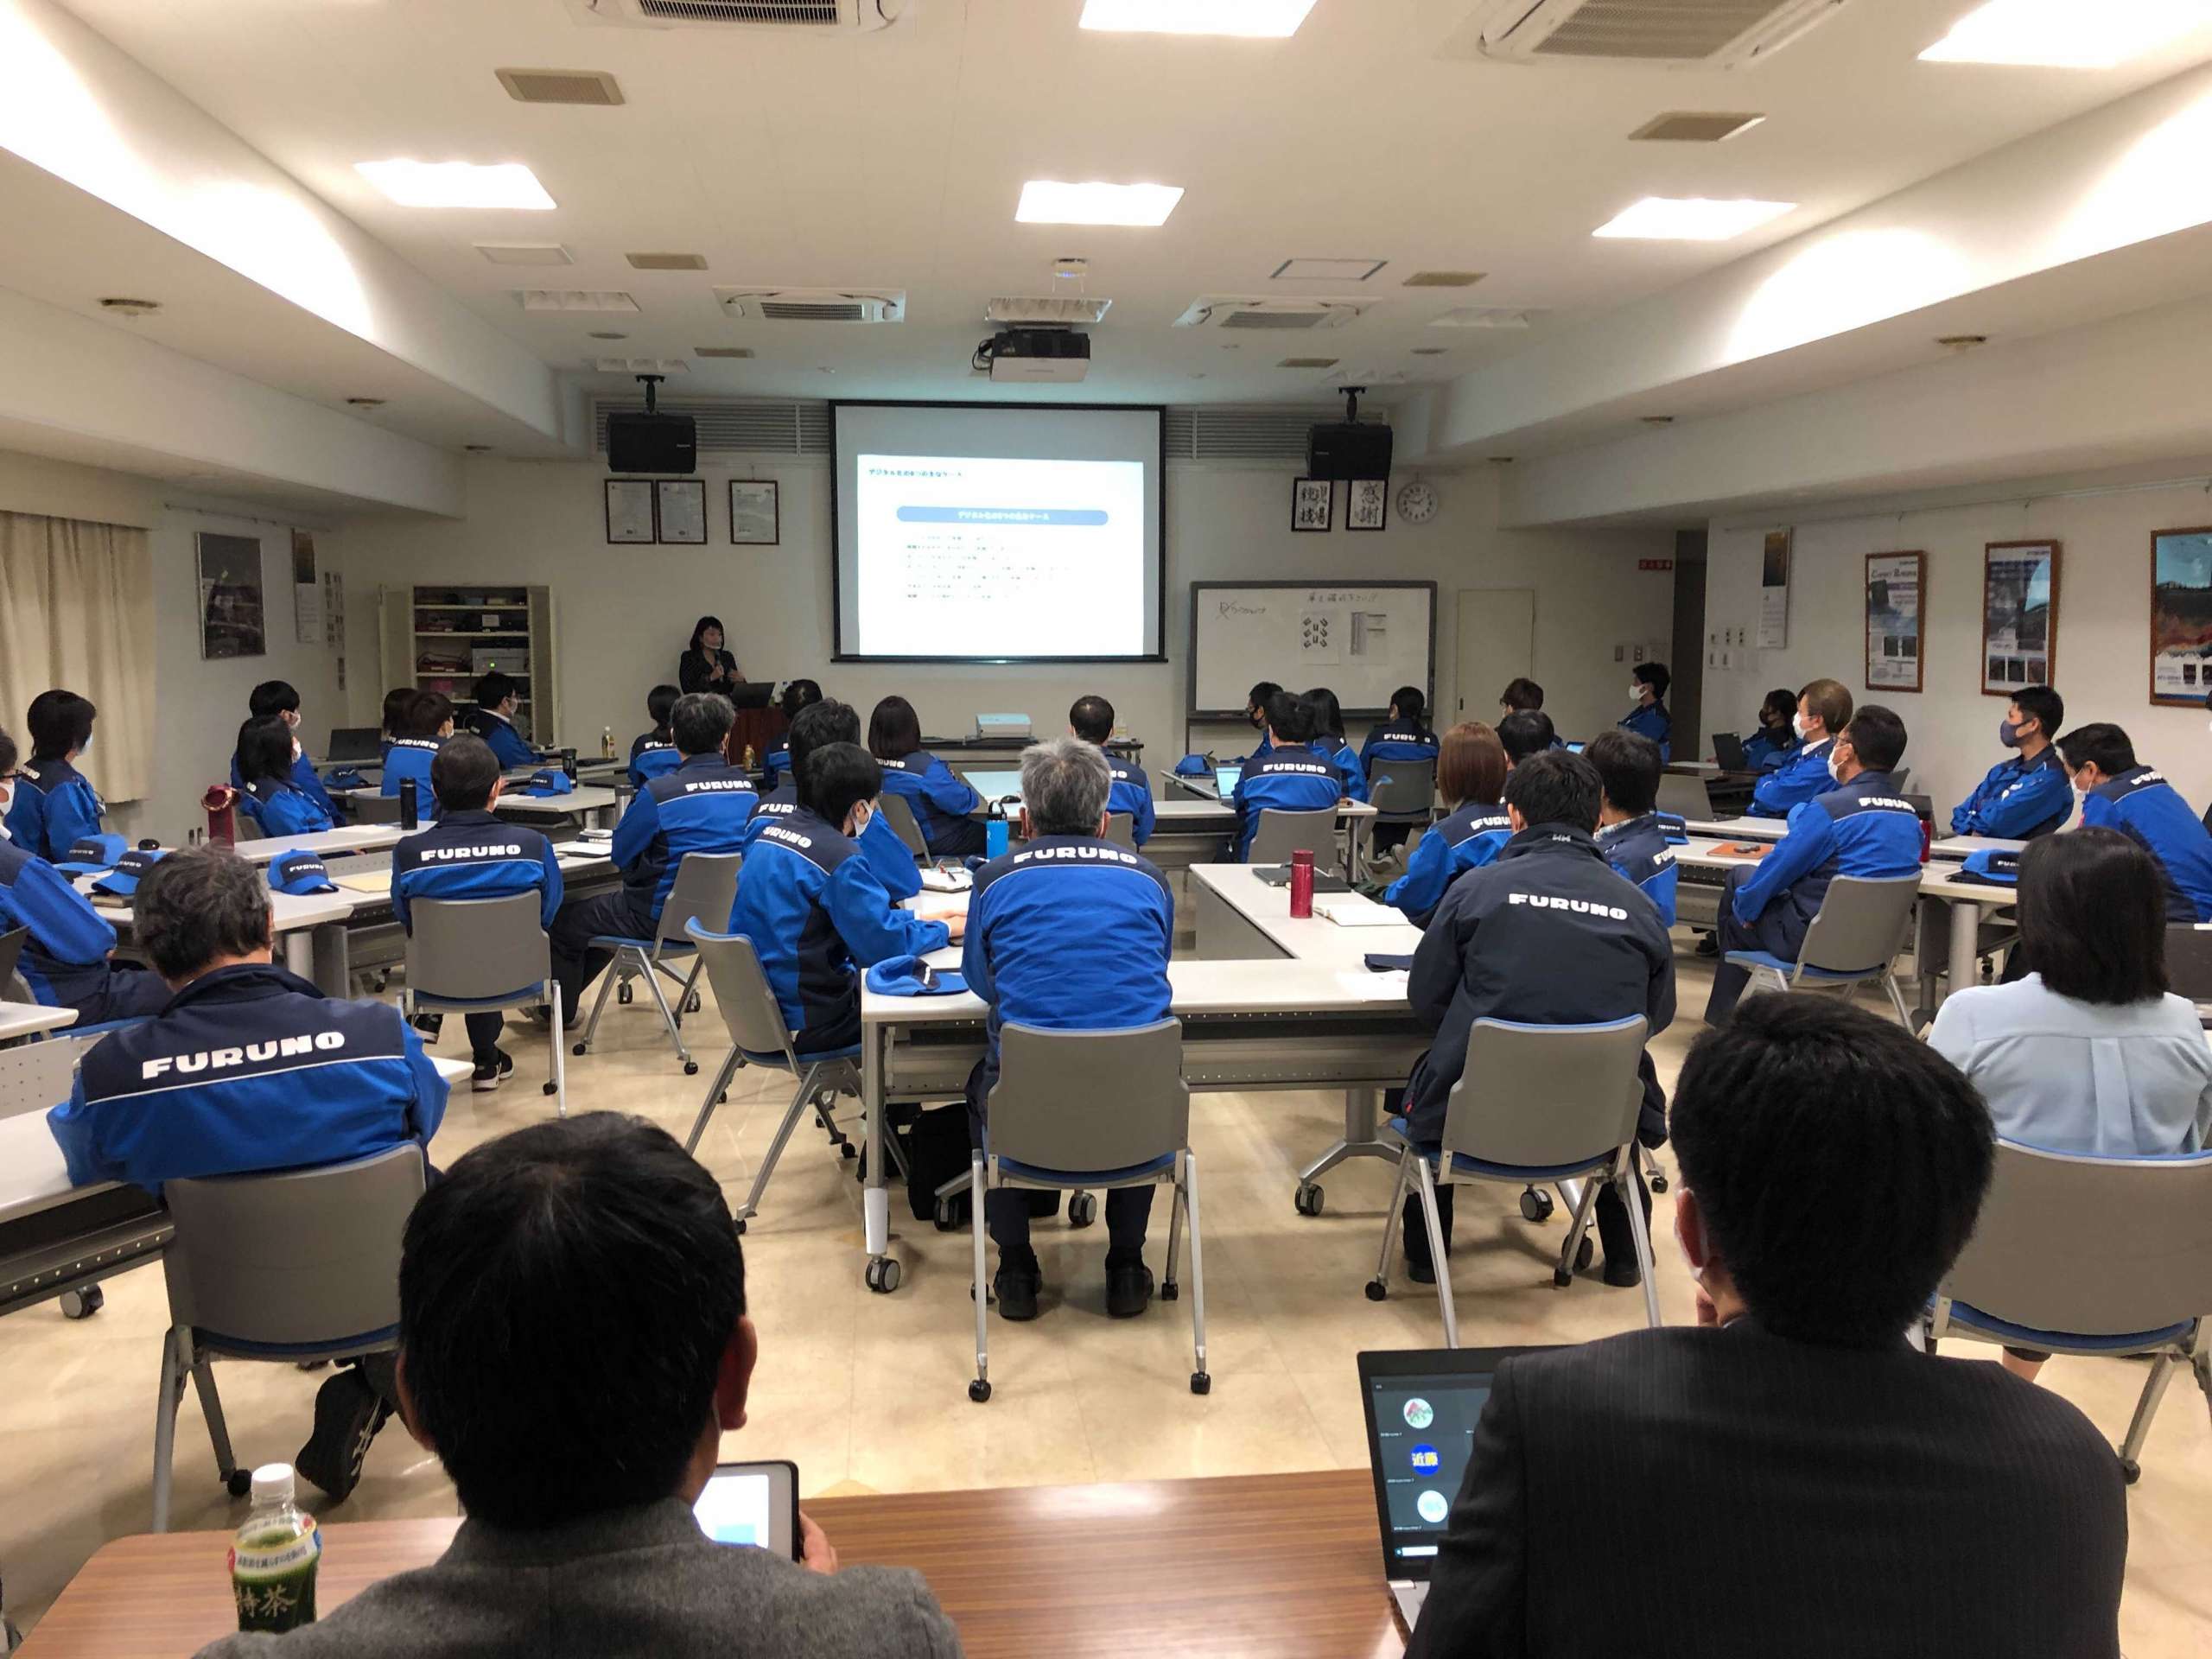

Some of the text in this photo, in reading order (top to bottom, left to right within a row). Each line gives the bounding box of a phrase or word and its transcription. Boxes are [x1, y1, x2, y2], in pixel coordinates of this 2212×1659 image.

[395, 738, 440, 750] URUNO
[1383, 733, 1431, 743] FURUO
[1262, 763, 1326, 774] FURUNO
[684, 779, 752, 792] FURUNO
[758, 803, 798, 814] FUR
[1859, 797, 1916, 814] FURUN
[420, 844, 522, 861] FURUNO
[1014, 846, 1138, 866] FURUNO
[1508, 892, 1629, 922] FURUNO
[141, 1031, 346, 1080] FURUNO
[236, 1583, 298, 1618] 特茶
